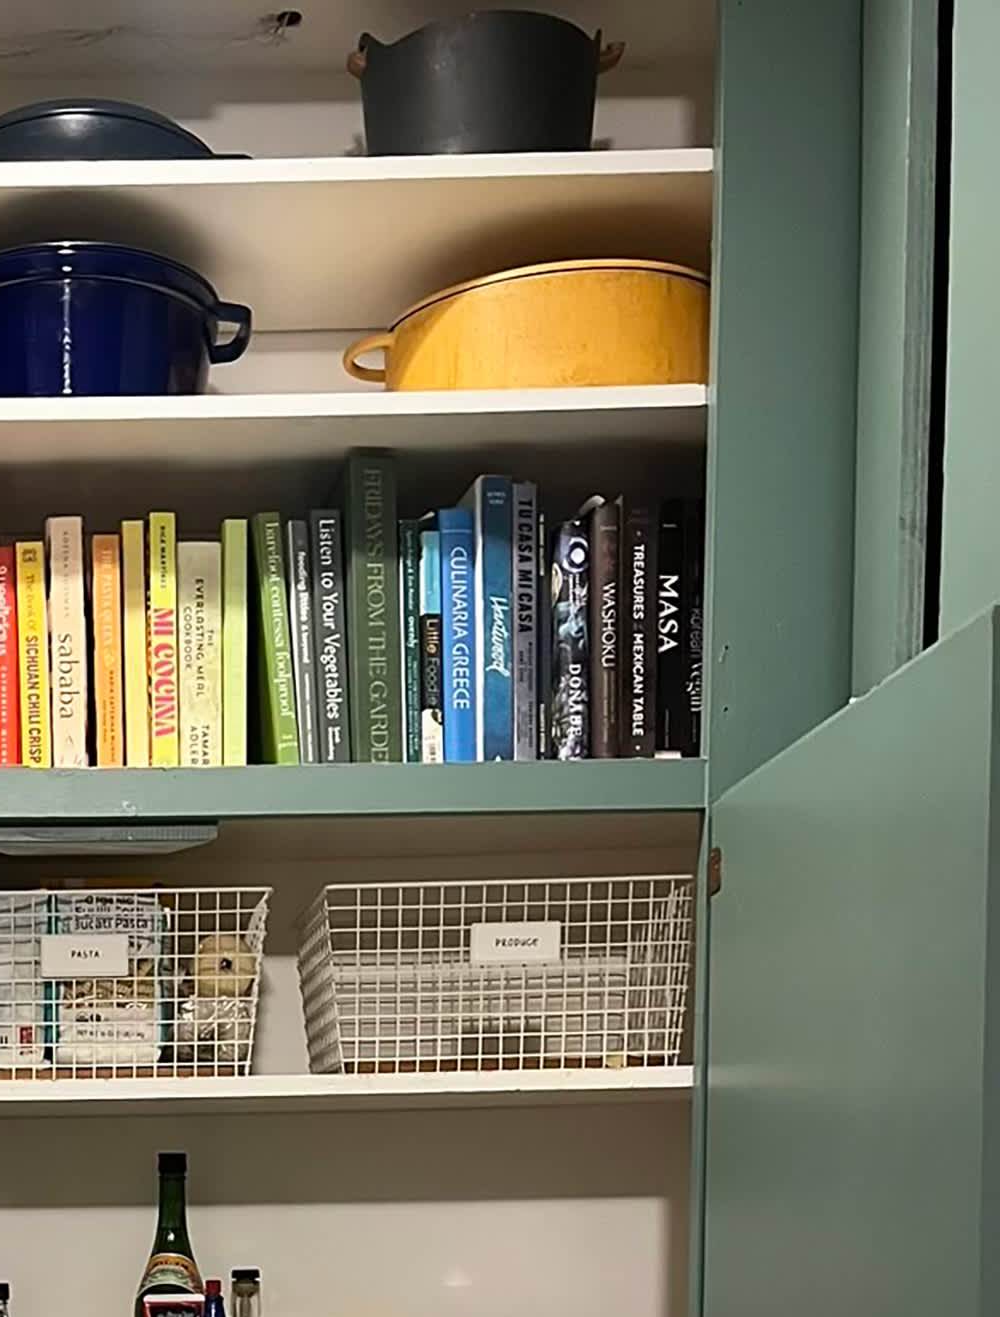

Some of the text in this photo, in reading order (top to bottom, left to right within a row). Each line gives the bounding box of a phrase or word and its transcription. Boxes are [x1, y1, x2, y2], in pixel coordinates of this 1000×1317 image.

[363, 467, 384, 558] FRIDAYS
[518, 499, 532, 519] TU
[318, 519, 336, 566] Listen
[518, 523, 533, 564] CASA
[296, 551, 309, 591] feeding
[320, 571, 337, 589] to
[518, 570, 534, 588] MI
[322, 592, 339, 630] Your
[366, 562, 385, 626] FROM
[518, 592, 533, 634] CASA
[657, 574, 679, 654] MASA
[153, 608, 174, 637] MI
[183, 606, 193, 670] COOKBOOK
[194, 578, 205, 697] EVERLASTING MEAL
[207, 629, 215, 647] THE
[264, 521, 296, 719] barefoot contessa foolproof
[406, 615, 418, 649] ovenly
[450, 546, 470, 710] CULINARIA GREECE
[485, 596, 510, 678] Hartwood
[601, 582, 617, 668] WASHOKU
[632, 544, 645, 737] TREASURES MEXICAN TABLE
[25, 636, 39, 690] SICHUAN
[368, 631, 387, 676] THE
[424, 618, 440, 706] Little Foodie
[58, 634, 80, 719] sababa
[154, 643, 176, 738] COCINA
[320, 634, 342, 720] Vegetables
[27, 693, 40, 725] CHILI
[29, 728, 42, 764] CRISP
[190, 725, 198, 765] ADLER
[201, 725, 210, 765] TAMAR
[115, 917, 148, 929] Pasta
[495, 937, 539, 948] PRODUCE
[71, 949, 100, 959] PASTA
